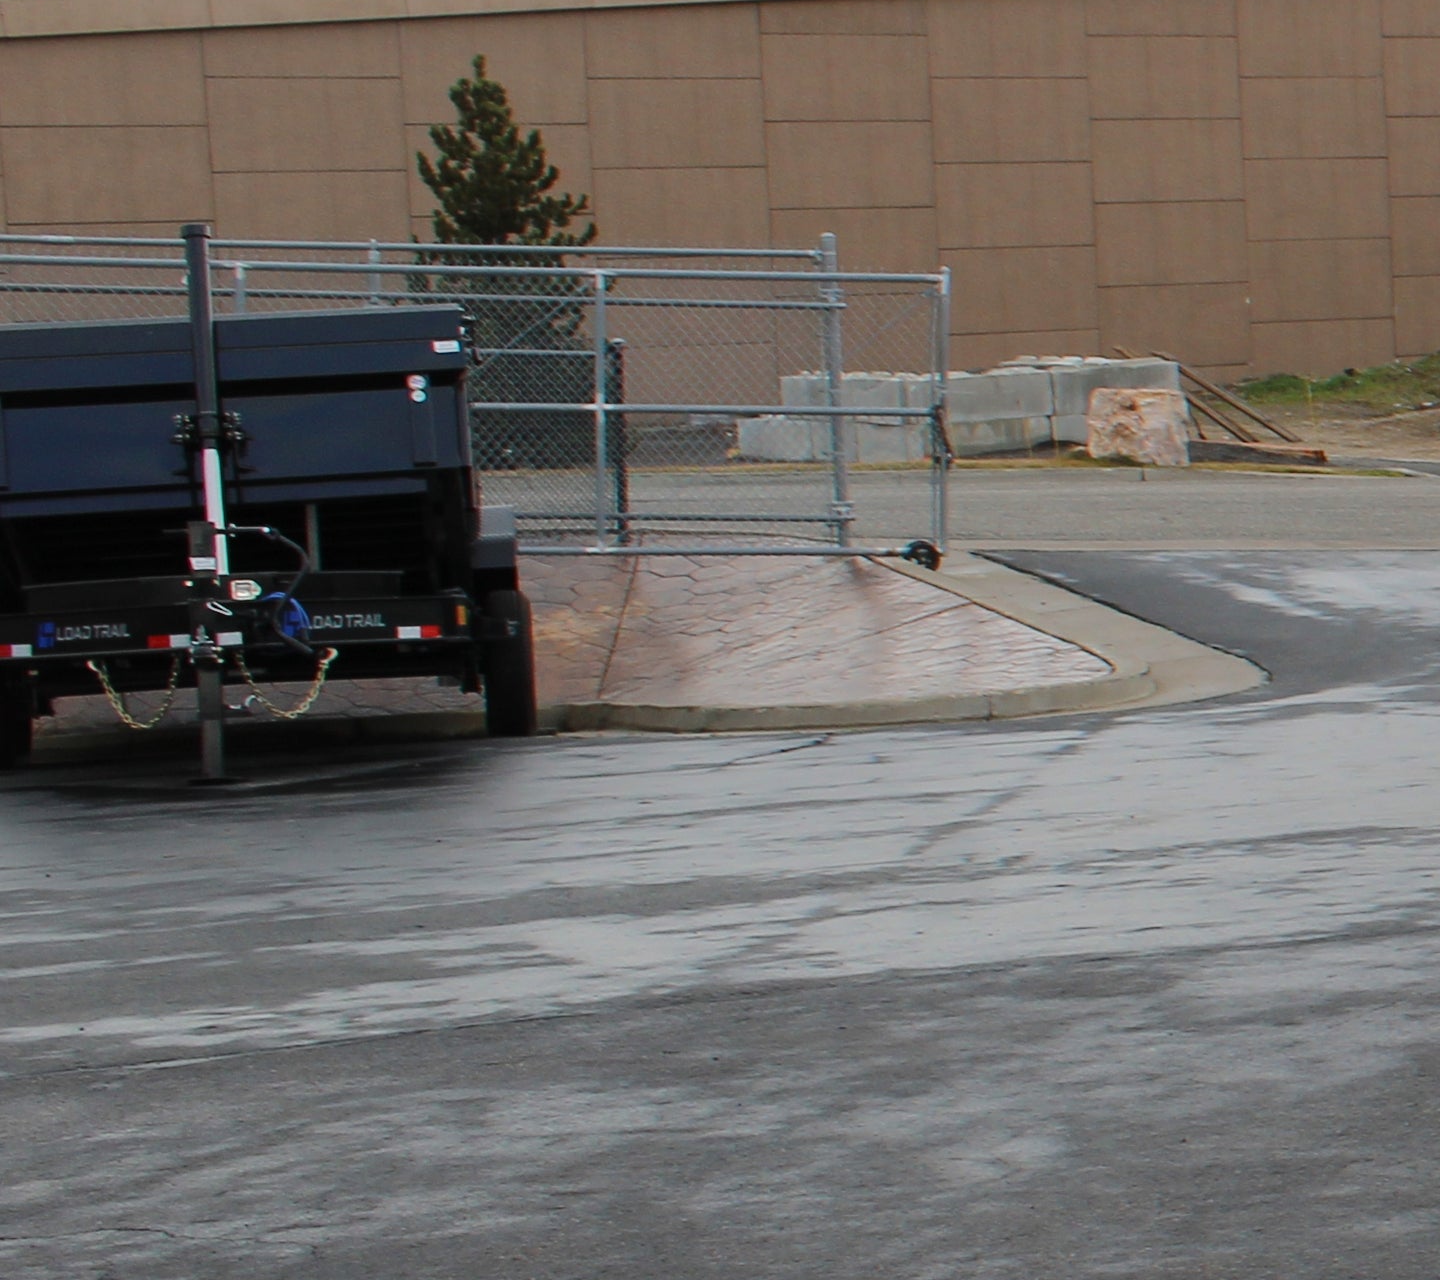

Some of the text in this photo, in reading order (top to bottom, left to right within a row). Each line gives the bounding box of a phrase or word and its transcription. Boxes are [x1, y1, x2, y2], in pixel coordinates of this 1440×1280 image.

[345, 614, 386, 628] TRAIL
[56, 623, 130, 641] LOAD TRAIL
